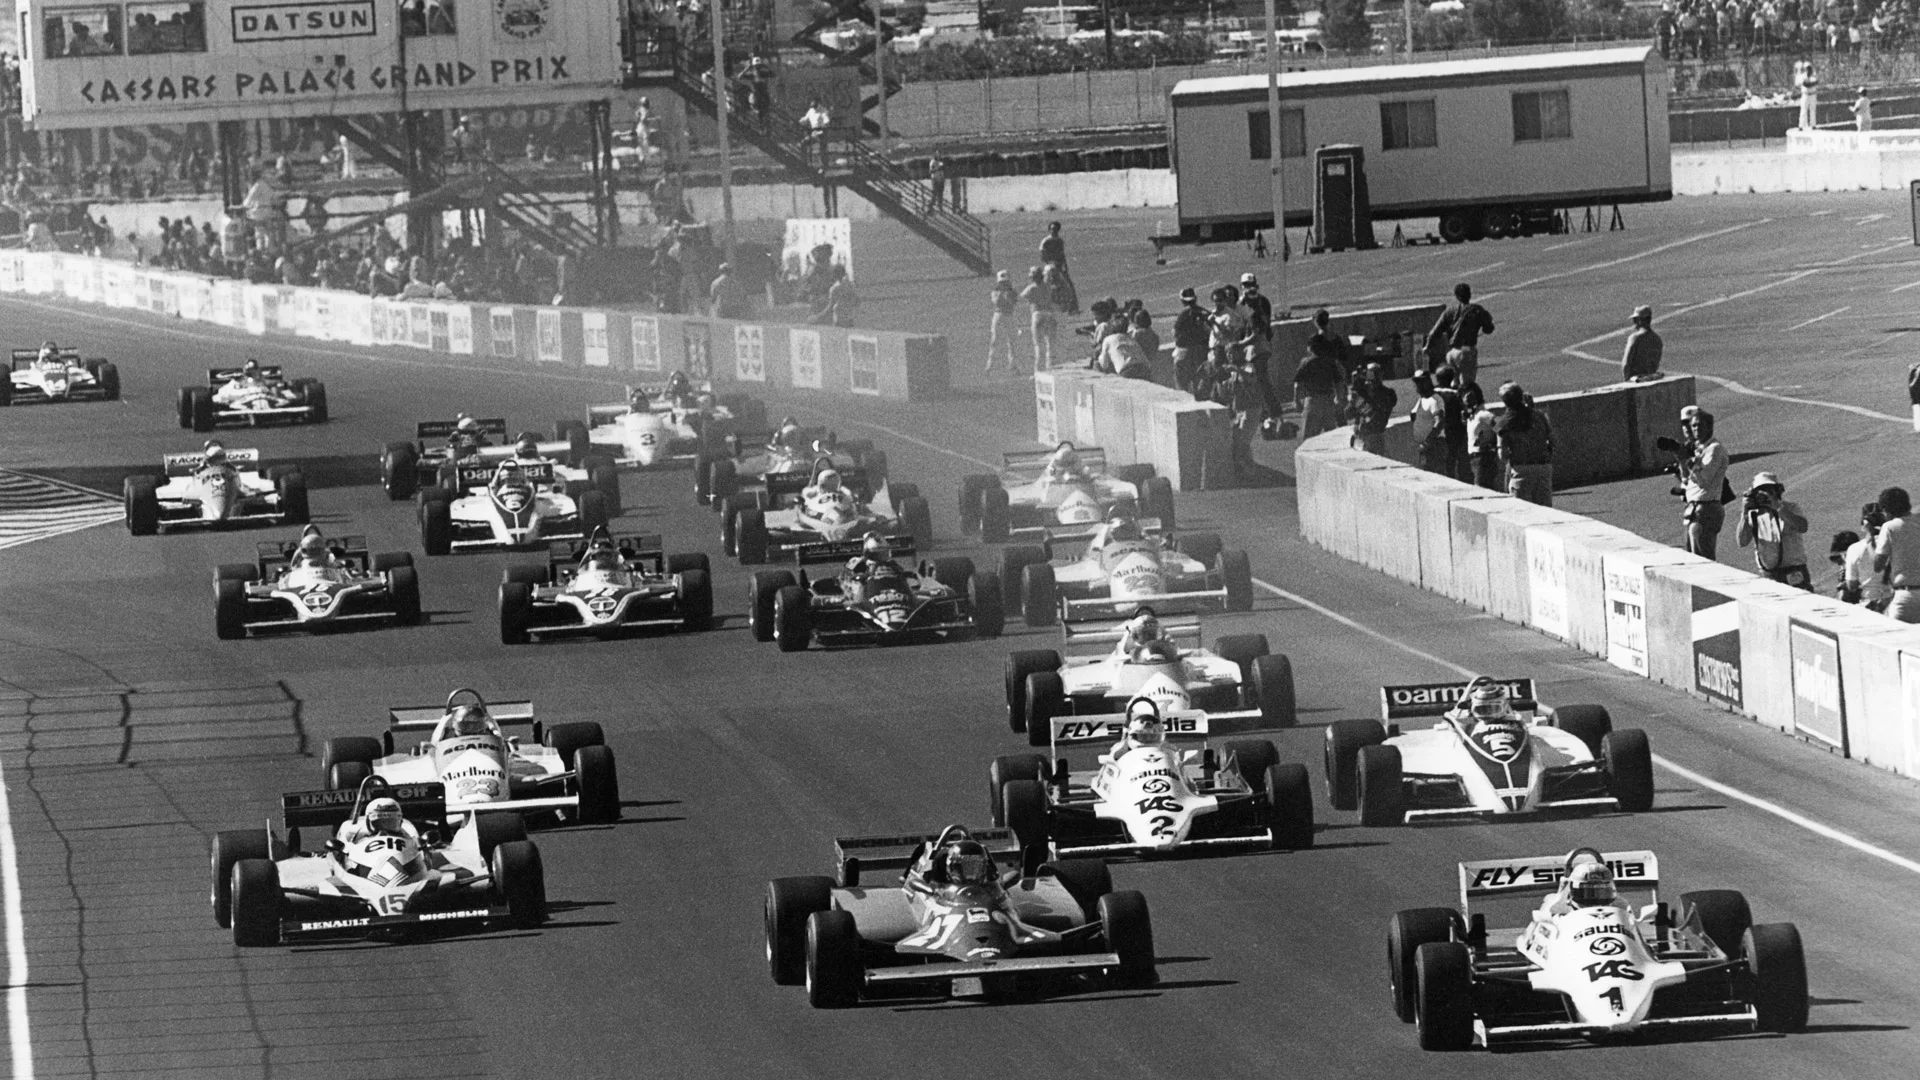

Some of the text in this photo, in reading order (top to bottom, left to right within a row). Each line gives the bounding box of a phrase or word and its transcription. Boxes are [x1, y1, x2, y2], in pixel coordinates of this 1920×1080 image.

[242, 10, 368, 32] DATSUN
[81, 56, 569, 103] CAESARS PALACE GRAND PRIX
[640, 433, 655, 446] 3
[1058, 721, 1105, 738] FLY
[442, 766, 506, 782] Marlboro
[456, 779, 500, 799] 23
[1150, 816, 1178, 837] 2
[364, 837, 406, 853] elf
[1472, 866, 1529, 888] FLY
[379, 894, 409, 915] 15
[301, 918, 371, 931] RENAULT
[419, 909, 489, 921] MICHELIN
[1599, 987, 1624, 1011] 1
